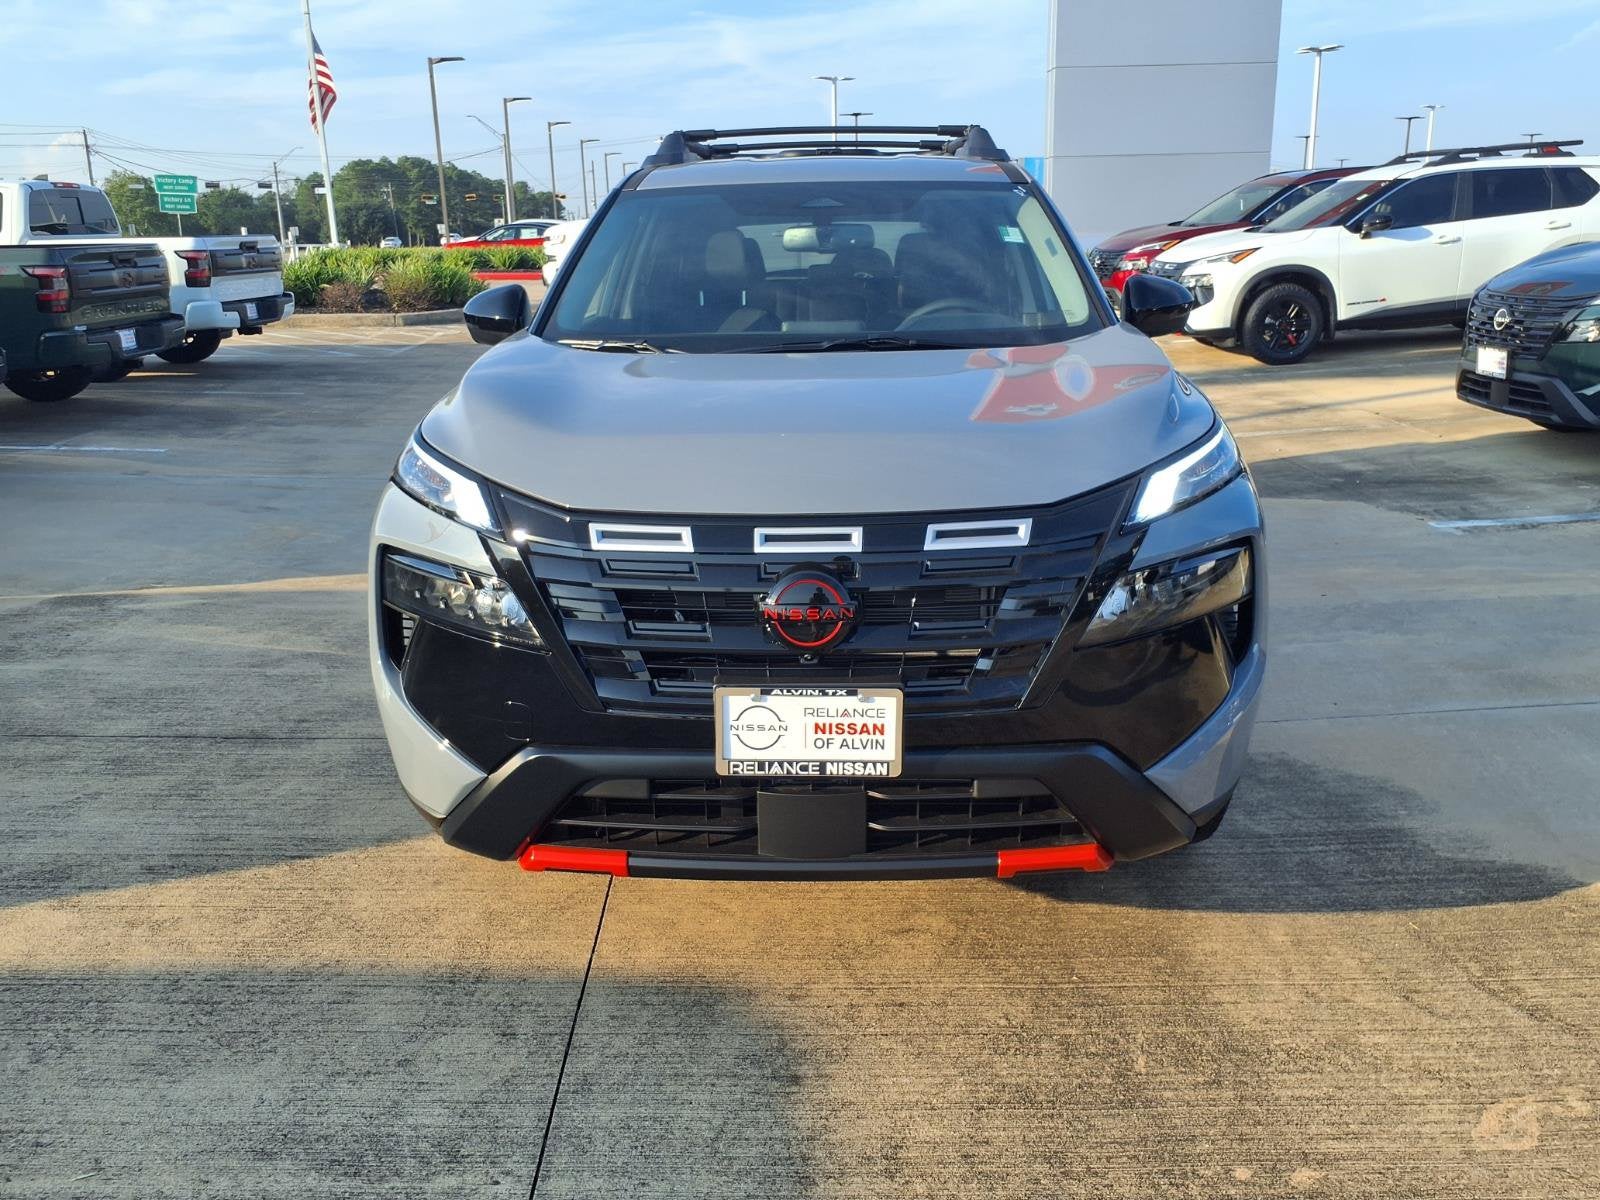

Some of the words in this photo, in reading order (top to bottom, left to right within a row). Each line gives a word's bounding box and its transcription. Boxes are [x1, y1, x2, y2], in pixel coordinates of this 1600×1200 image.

[763, 607, 854, 620] NISSAN
[804, 707, 886, 719] RELIANCE
[730, 724, 788, 732] NISSAN
[814, 722, 885, 736] NISSAN
[814, 737, 835, 750] OF
[839, 737, 885, 750] ALVIN
[729, 761, 820, 775] RELIANCE
[826, 762, 888, 776] NISSAN
